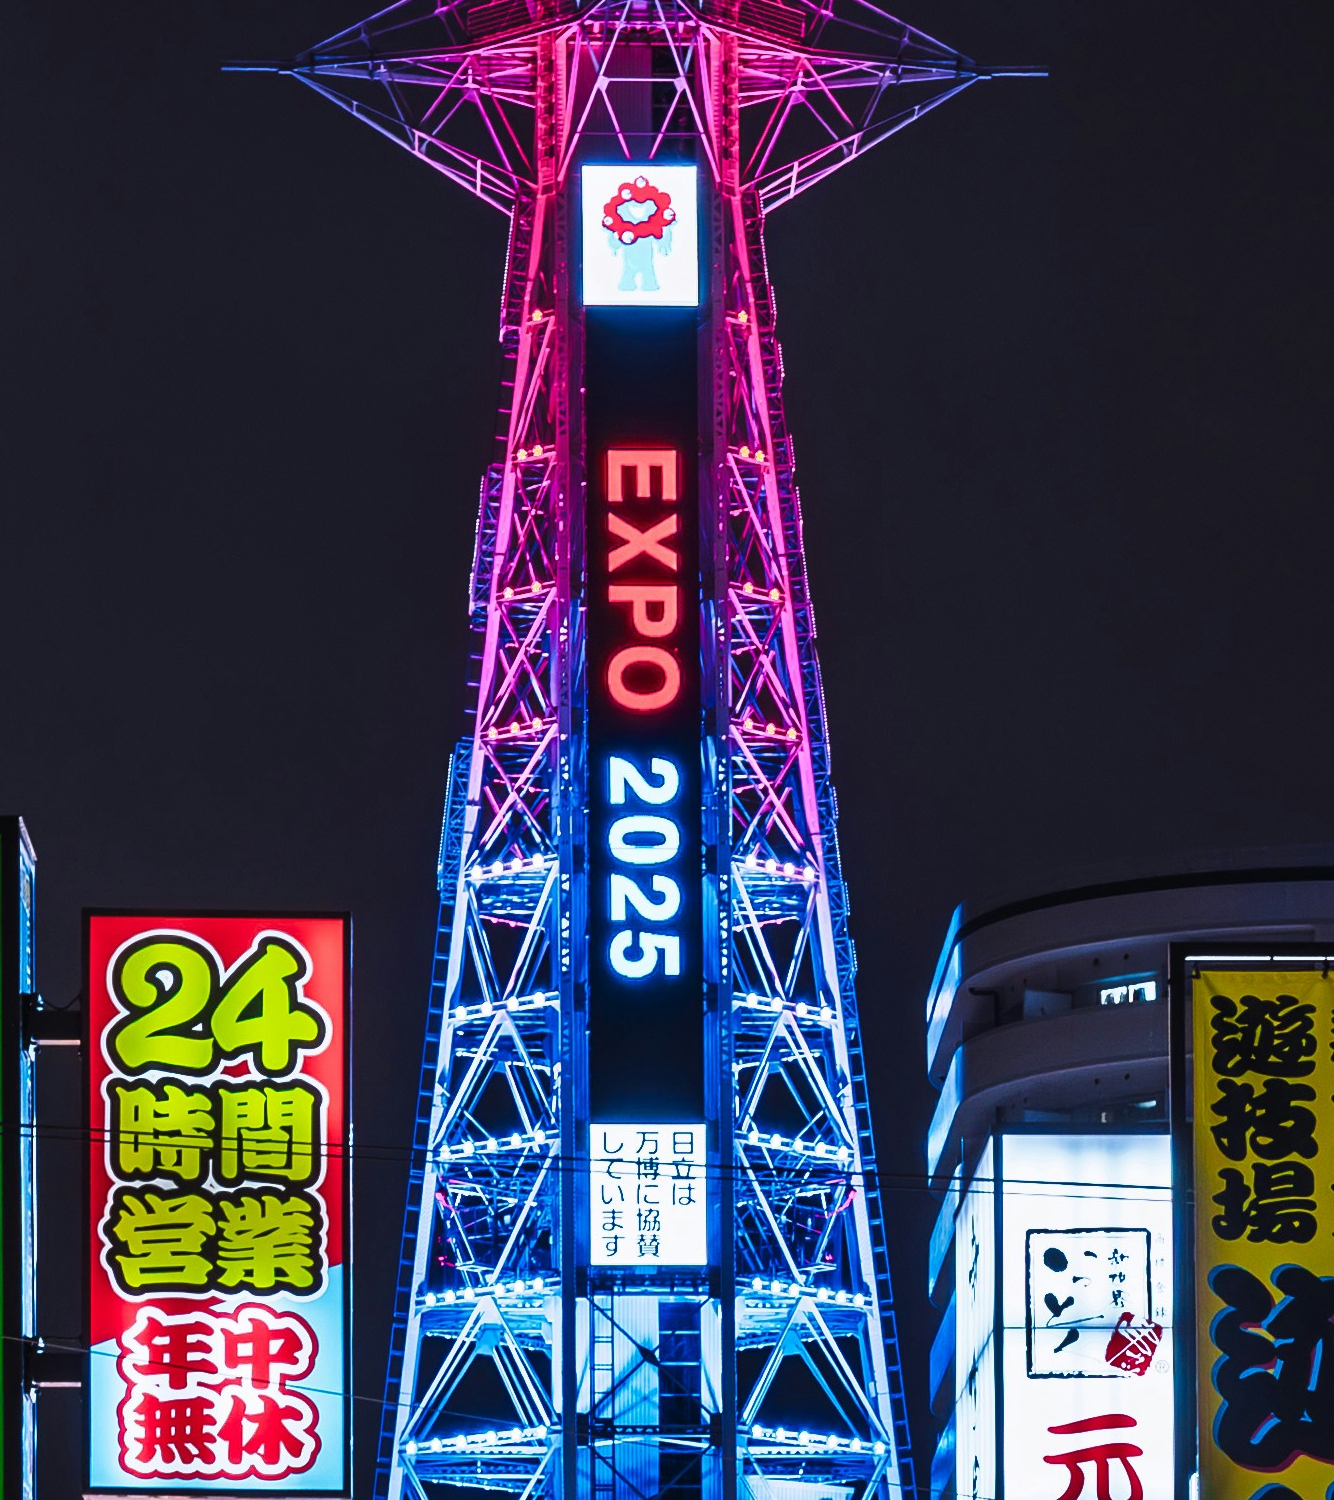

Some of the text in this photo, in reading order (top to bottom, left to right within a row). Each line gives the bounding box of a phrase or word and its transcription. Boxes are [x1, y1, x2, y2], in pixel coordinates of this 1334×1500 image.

[604, 447, 683, 981] EXPO 2025
[113, 938, 321, 1074] 24
[109, 1082, 323, 1186] 時間
[671, 1132, 696, 1206] 日立は
[1211, 995, 1319, 1244] 遊技場
[109, 1188, 323, 1293] 営業
[601, 1132, 626, 1257] しています
[636, 1132, 661, 1258] 万博に協賛
[125, 1310, 312, 1390] 年中
[125, 1394, 312, 1468] 無休
